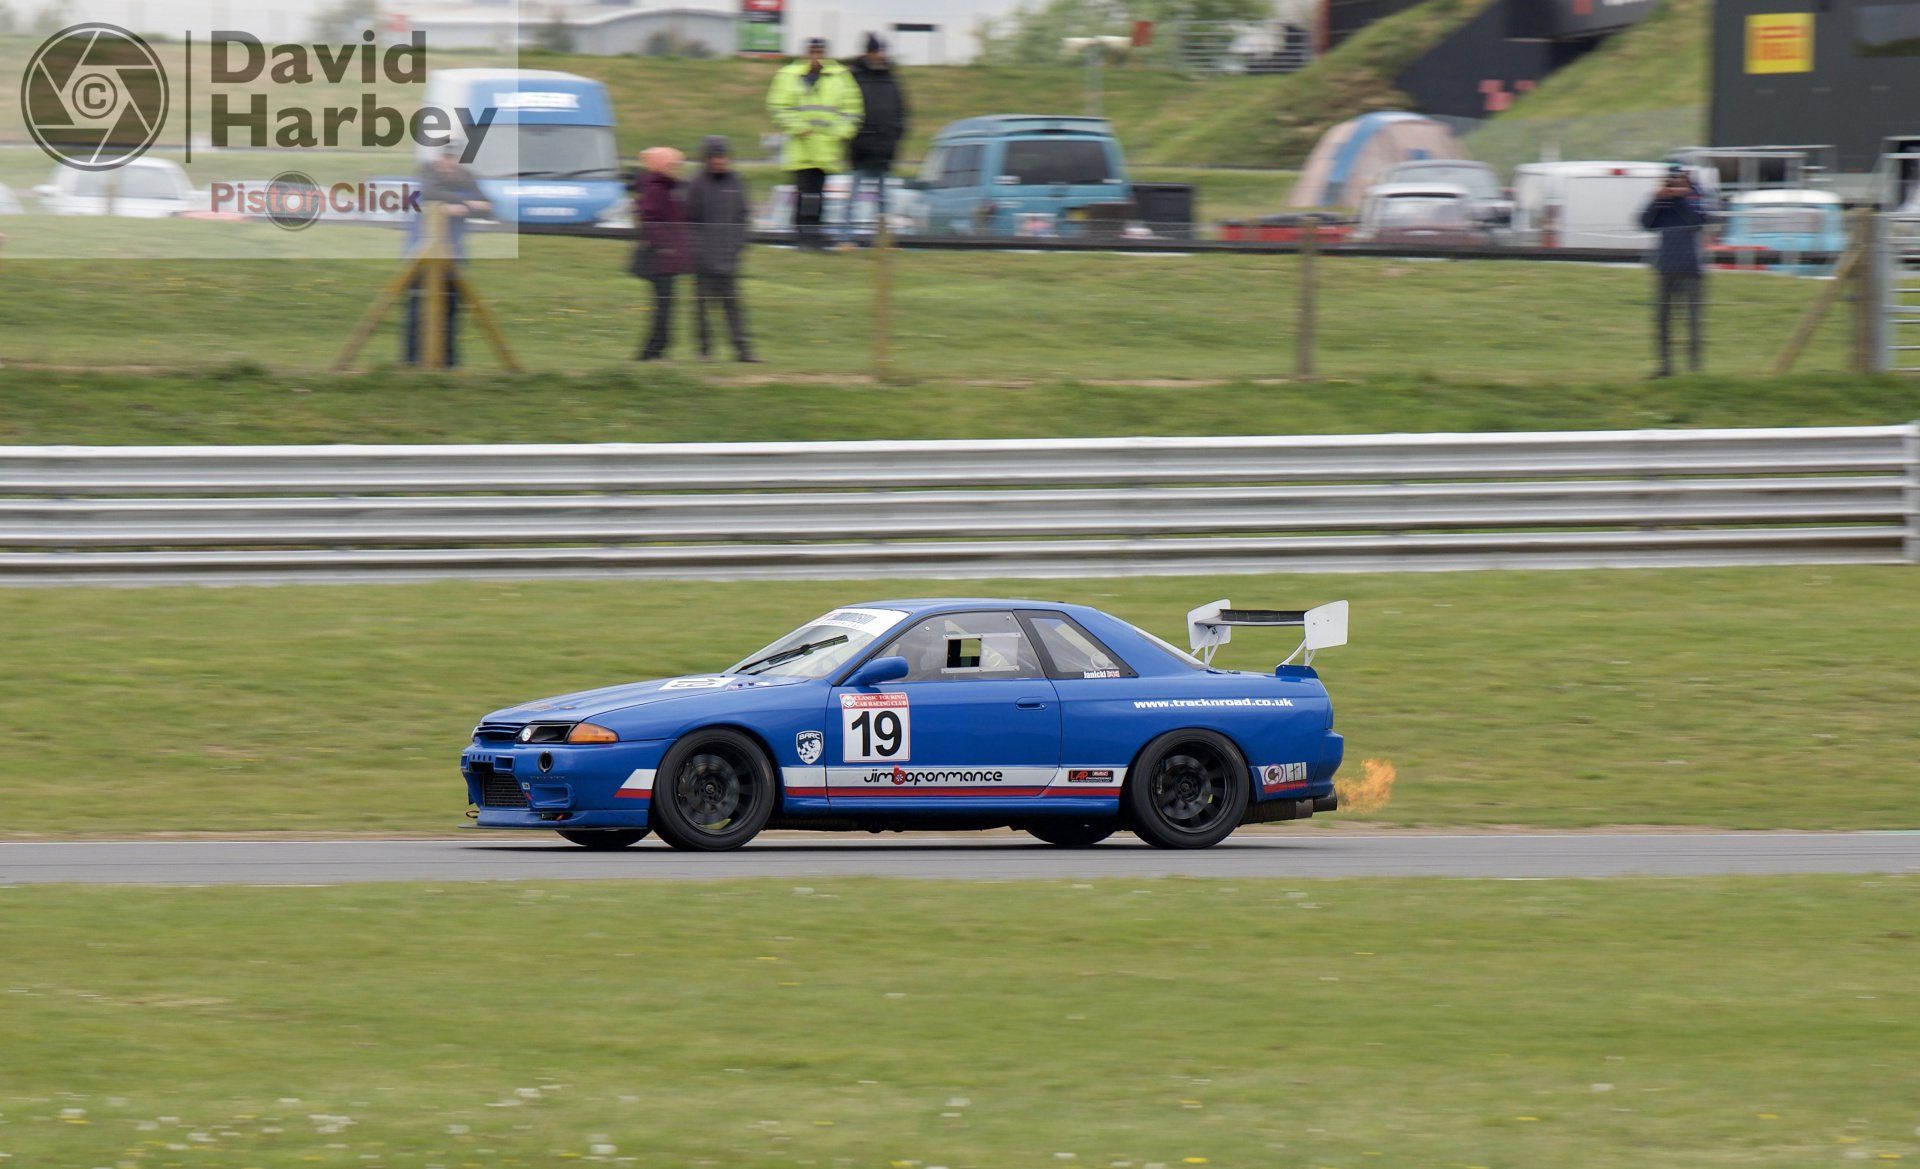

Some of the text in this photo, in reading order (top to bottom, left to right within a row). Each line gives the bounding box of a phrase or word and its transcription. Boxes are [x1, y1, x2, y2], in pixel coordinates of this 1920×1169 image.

[1133, 697, 1294, 709] www.tracknroad.co.uk
[799, 732, 821, 740] BARC
[851, 710, 902, 757] 19
